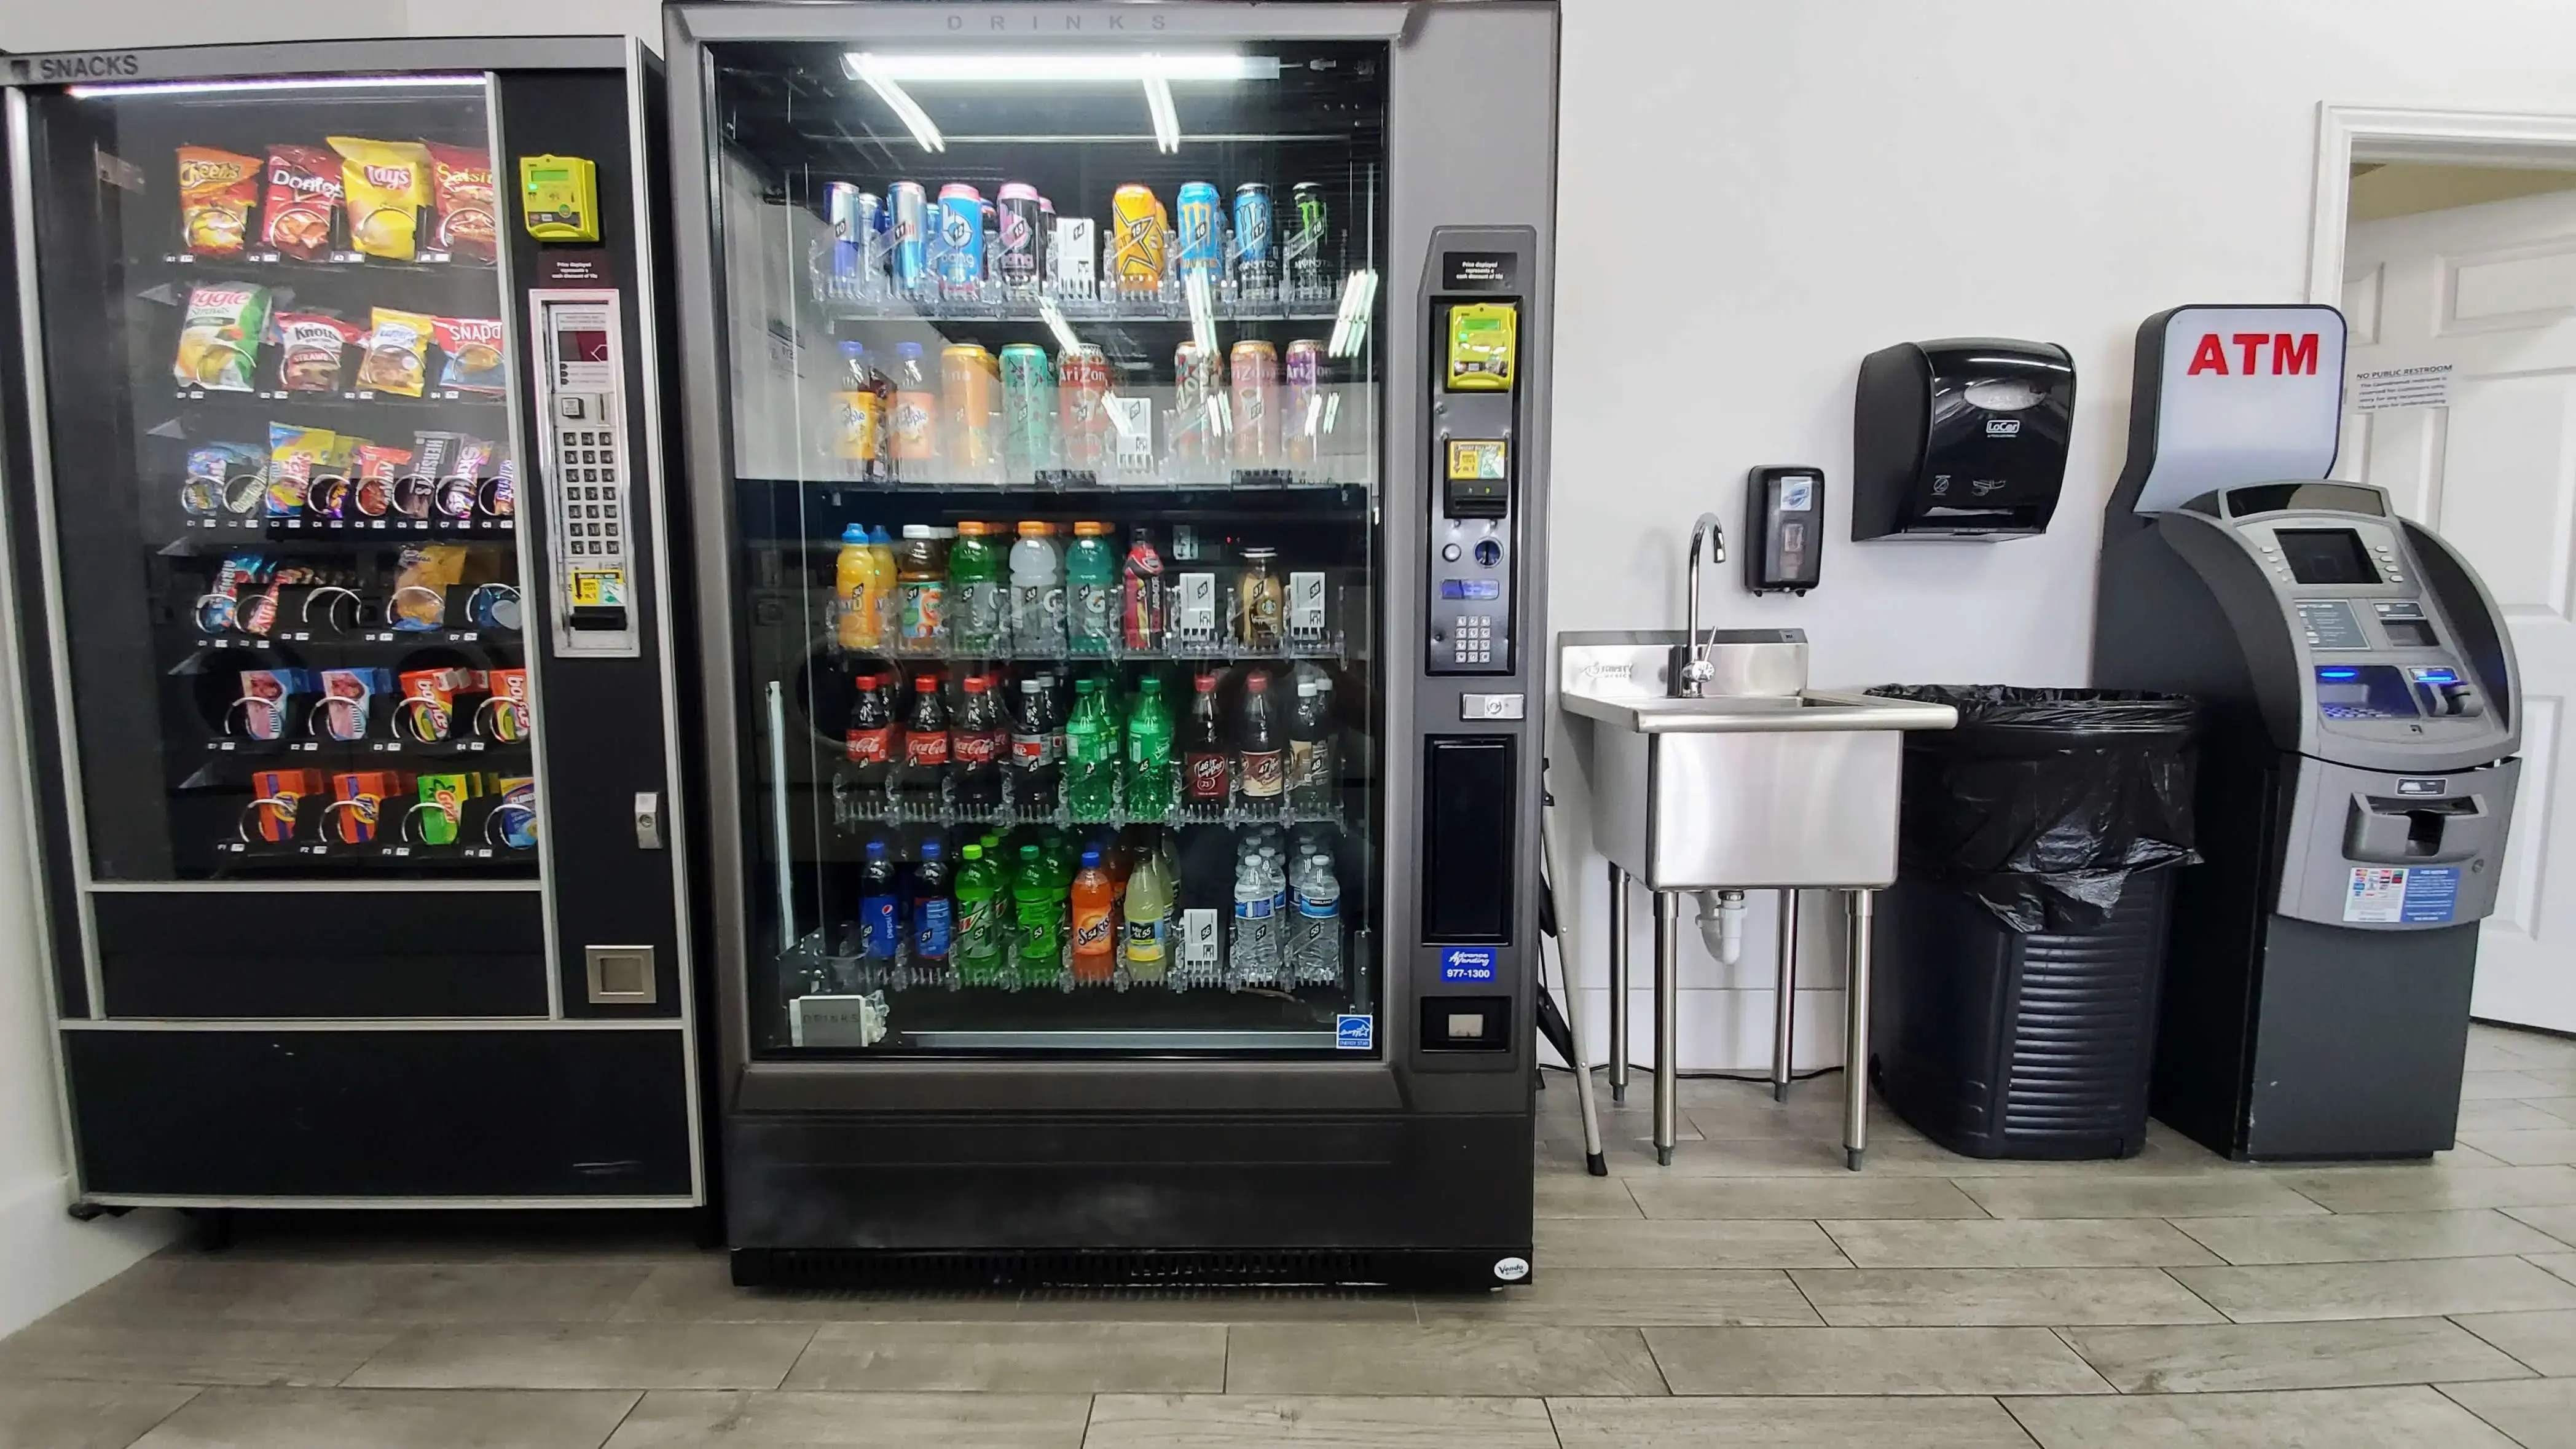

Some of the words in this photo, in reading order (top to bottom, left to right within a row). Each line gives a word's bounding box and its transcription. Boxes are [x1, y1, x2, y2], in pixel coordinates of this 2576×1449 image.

[947, 15, 1166, 30] DRINKS
[40, 54, 139, 80] SNACKS
[180, 160, 241, 189] Cheetos
[272, 168, 344, 198] Doritos
[836, 222, 846, 234] 10
[895, 226, 906, 237] 11
[954, 226, 964, 238] 12
[1015, 222, 1024, 238] 13
[1074, 225, 1085, 239] 14
[1132, 224, 1142, 237] 15
[1196, 226, 1206, 238] 16
[1254, 224, 1264, 237] 17
[2186, 333, 2319, 375] ATM
[2371, 369, 2401, 379] PUBLIC
[2403, 364, 2453, 375] RESTROOM
[907, 588, 918, 599] 31
[1254, 583, 1263, 596] 37
[1028, 760, 1039, 772] 43
[1139, 760, 1149, 771] 45
[1199, 761, 1209, 772] 46
[1258, 762, 1270, 774] 47
[1311, 759, 1321, 771] 48
[863, 925, 873, 937] 50
[921, 931, 931, 941] 51
[974, 928, 983, 938] 52
[1034, 927, 1043, 938] 53
[1088, 930, 1098, 941] 54
[1141, 928, 1151, 940] 55
[1201, 927, 1211, 939] 56
[1256, 927, 1266, 939] 57
[1310, 925, 1320, 937] 58
[1448, 951, 1489, 962] Advance
[1454, 957, 1490, 967] Vending
[1447, 968, 1490, 978] 977-1300
[1498, 1263, 1524, 1274] Vendo
